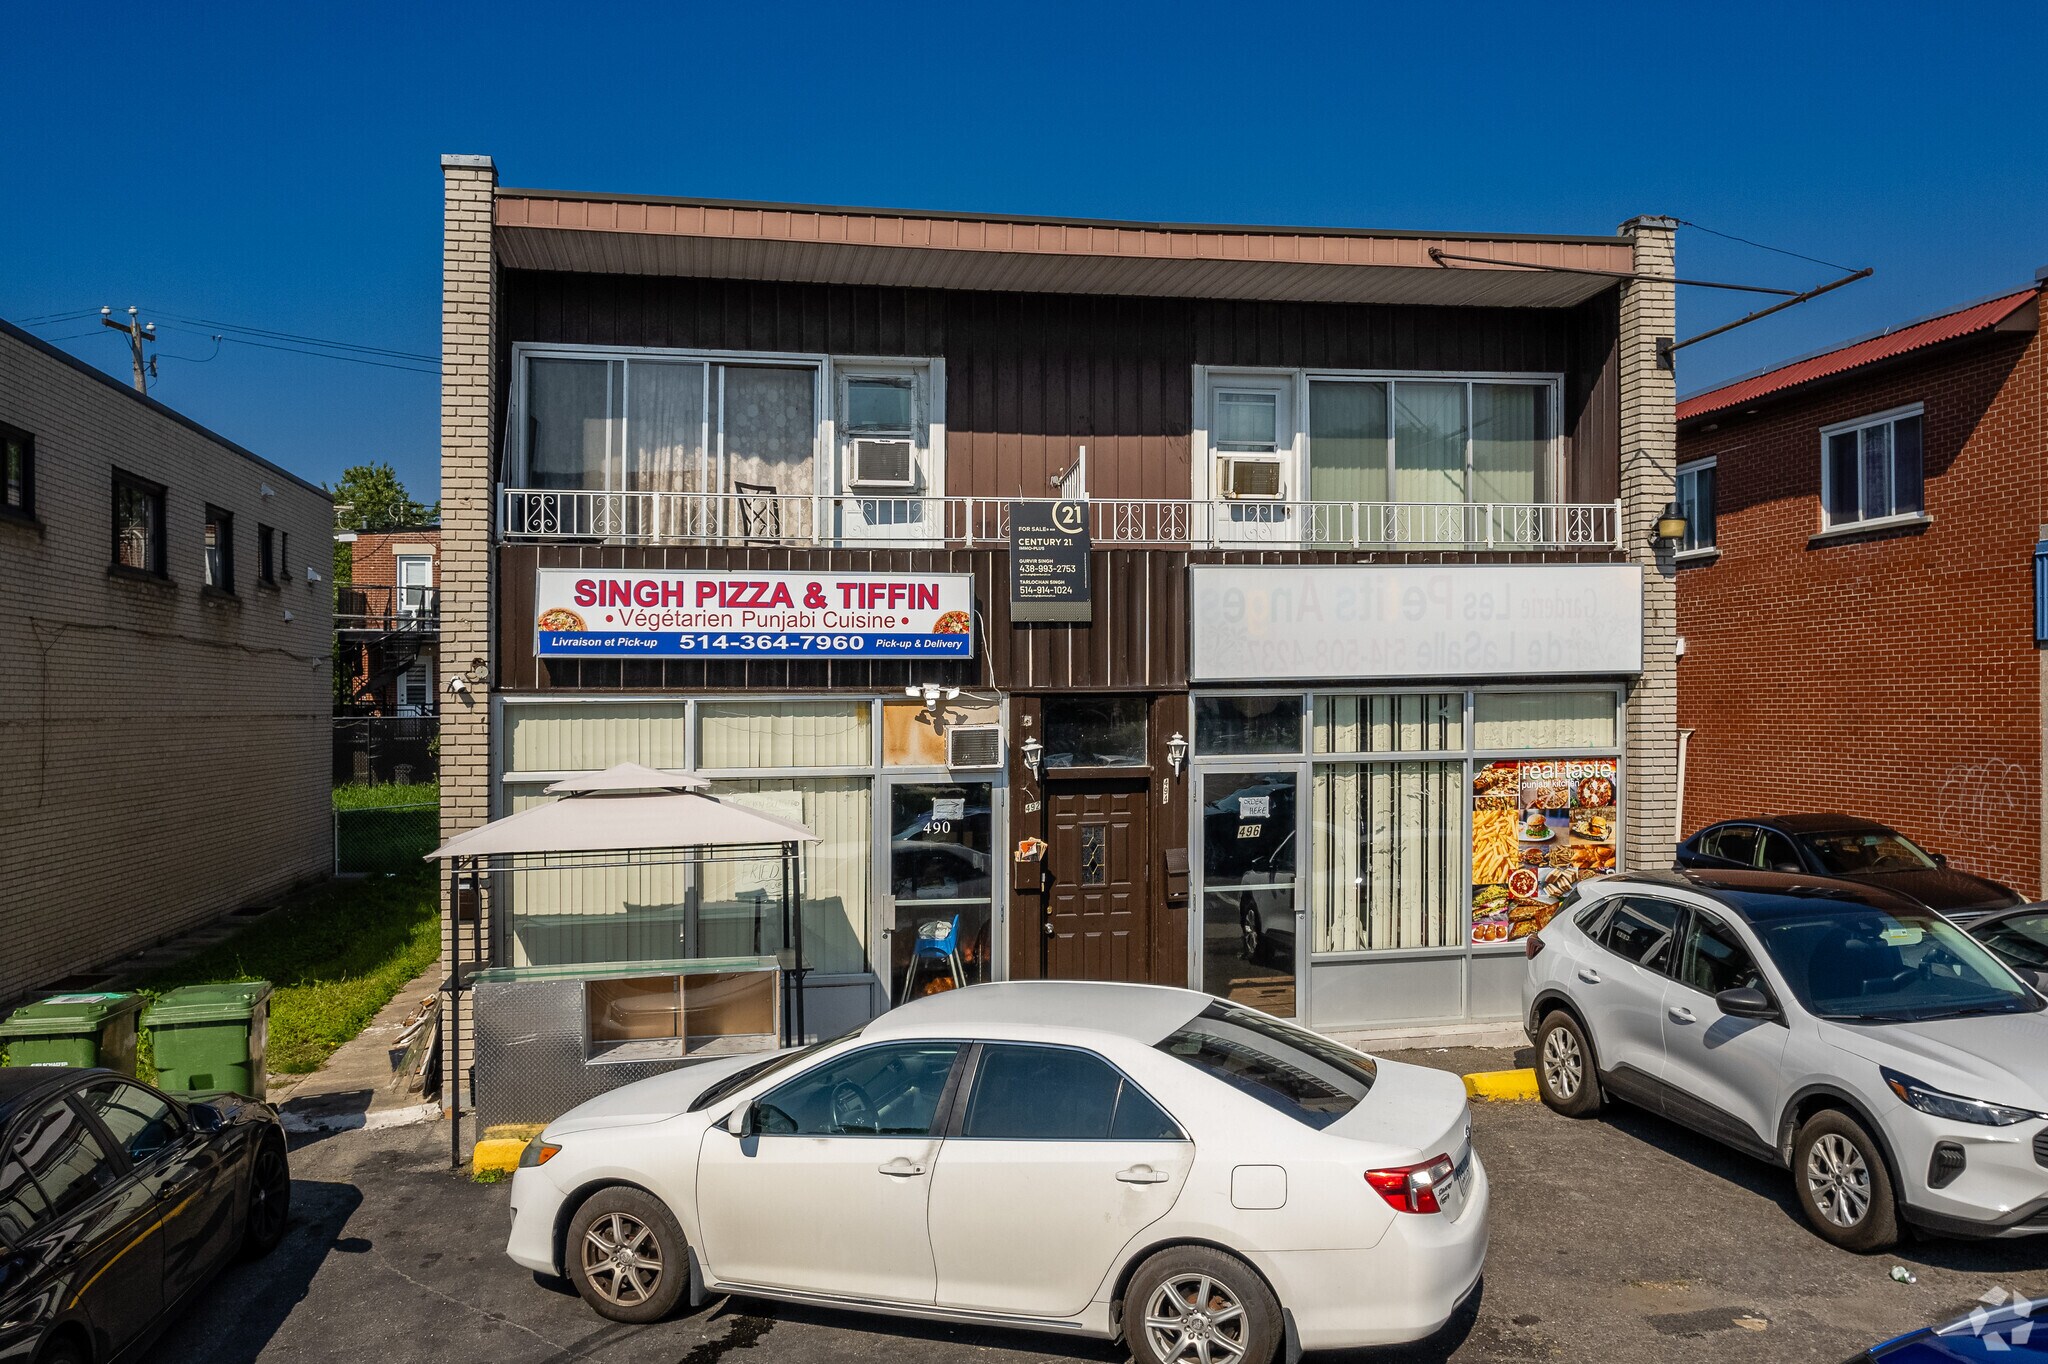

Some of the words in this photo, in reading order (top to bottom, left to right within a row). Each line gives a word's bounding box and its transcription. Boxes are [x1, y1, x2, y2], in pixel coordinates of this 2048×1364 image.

[1018, 538, 1062, 546] CENTURY
[1063, 538, 1074, 546] 21
[1019, 564, 1076, 573] 438-993-2753
[574, 578, 684, 608] SINGH
[695, 580, 795, 609] PIZZA
[803, 581, 828, 610] &
[836, 582, 939, 610] TIFFIN
[1019, 586, 1073, 595] 514-914-1024
[618, 608, 732, 631] Végétarien
[742, 610, 815, 632] Punjabi
[823, 611, 896, 628] Cuisine
[552, 637, 602, 647] Livraison
[604, 638, 615, 647] et
[617, 638, 658, 649] Pick-up
[679, 634, 865, 650] 514-364-7960
[875, 639, 912, 649] Pick-up
[914, 640, 922, 648] &
[924, 640, 963, 650] Delivery
[1522, 761, 1558, 781] real
[1565, 760, 1612, 780] taste
[1521, 780, 1551, 791] punjabi
[1552, 779, 1580, 788] kitchen
[1025, 801, 1041, 813] 492
[1250, 806, 1267, 815] HERE
[922, 821, 951, 835] 490
[1239, 825, 1260, 837] 496
